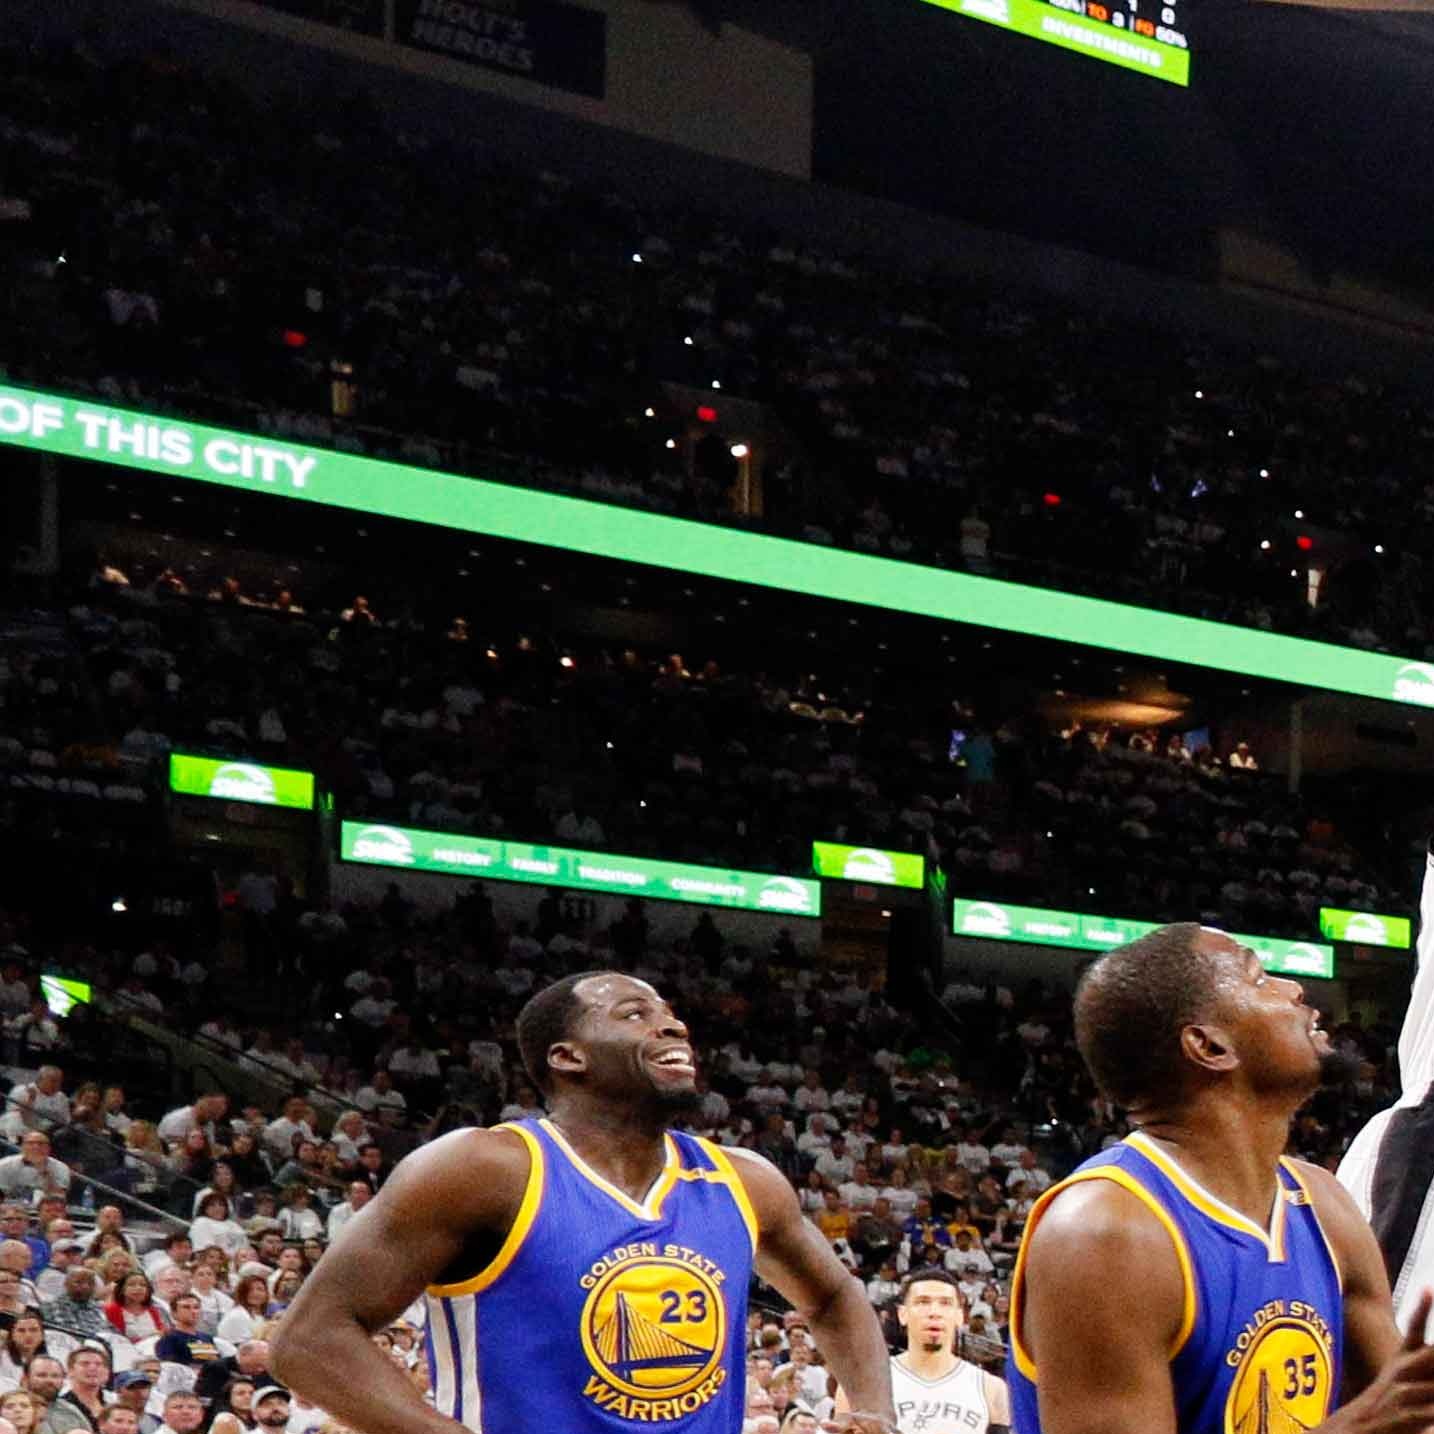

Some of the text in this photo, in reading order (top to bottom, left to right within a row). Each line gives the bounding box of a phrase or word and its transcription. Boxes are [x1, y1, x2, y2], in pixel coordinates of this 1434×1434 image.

[0, 397, 319, 488] OF THIS CITY
[579, 1243, 728, 1290] GOLDEN STATE
[660, 1289, 708, 1323] 23
[1225, 1300, 1335, 1368] GOLDEN STATE
[582, 1366, 728, 1422] WARRIORS
[1283, 1354, 1317, 1400] 35
[897, 1400, 982, 1430] PURS
